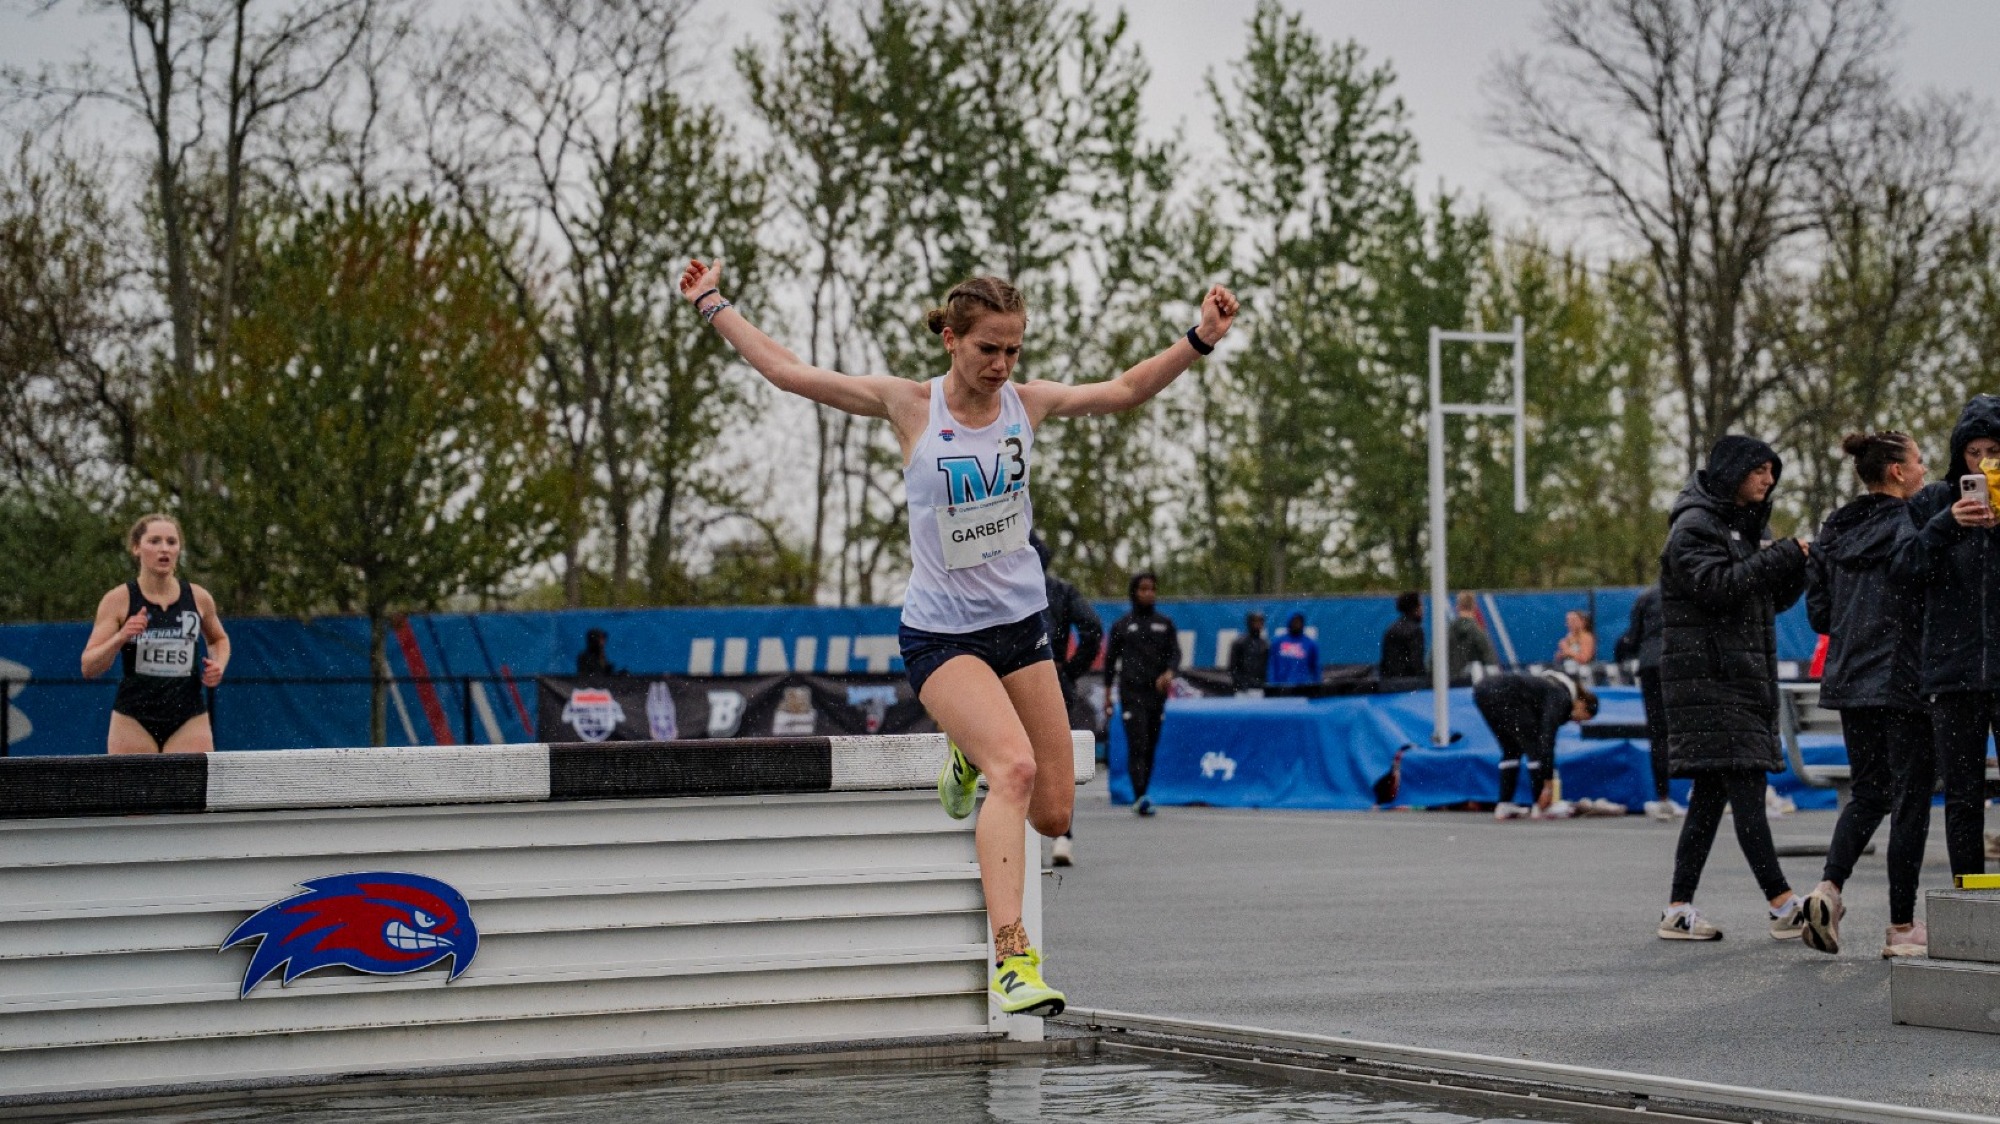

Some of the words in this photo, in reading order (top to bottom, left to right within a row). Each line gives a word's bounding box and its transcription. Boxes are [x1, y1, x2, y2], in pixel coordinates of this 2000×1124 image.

[1005, 437, 1025, 481] 3
[952, 513, 1018, 543] GARBETT
[187, 614, 196, 639] 2
[143, 649, 188, 665] LEES
